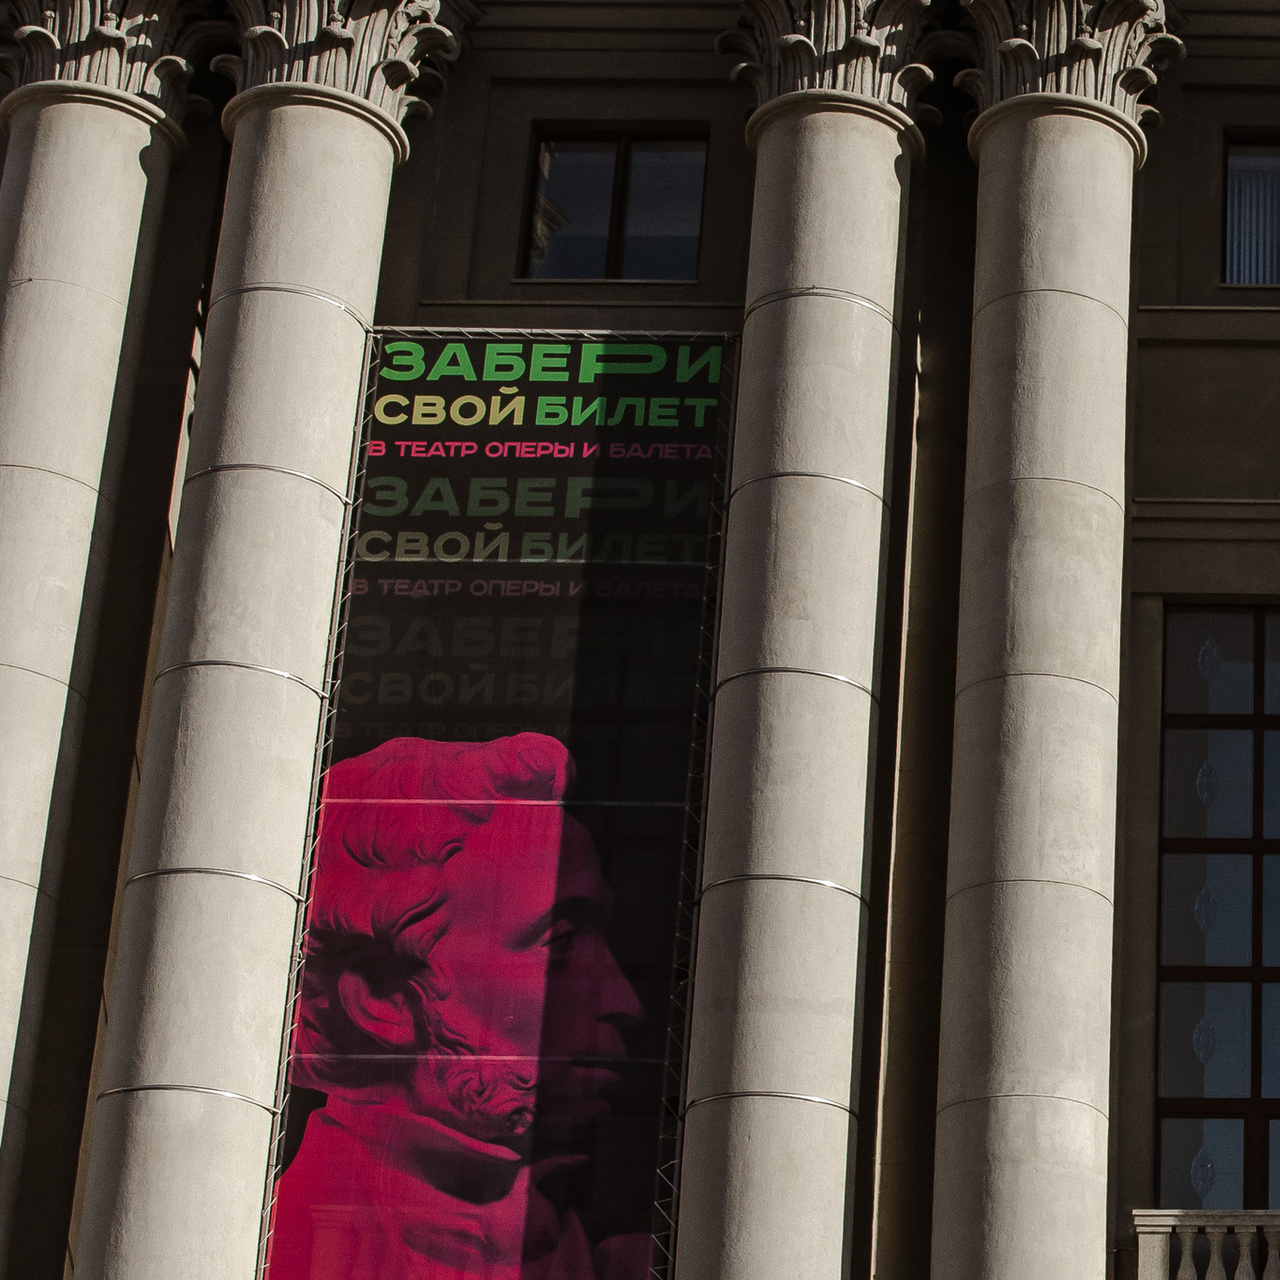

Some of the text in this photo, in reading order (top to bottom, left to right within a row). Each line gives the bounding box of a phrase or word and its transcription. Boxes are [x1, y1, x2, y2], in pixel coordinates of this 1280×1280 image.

[379, 341, 722, 383] ЗАБЕРИ
[374, 386, 718, 427] СВОЙ БИЛЕТ
[368, 440, 713, 459] В ТЕАТР ОПЕРЫ И БАЛЕТА
[363, 476, 713, 518] ЗАБЕРИ
[357, 522, 707, 564] СВОЙ БИЛЕТ
[378, 579, 462, 596] ТЕАТР
[469, 580, 561, 597] ОПЕРЫ
